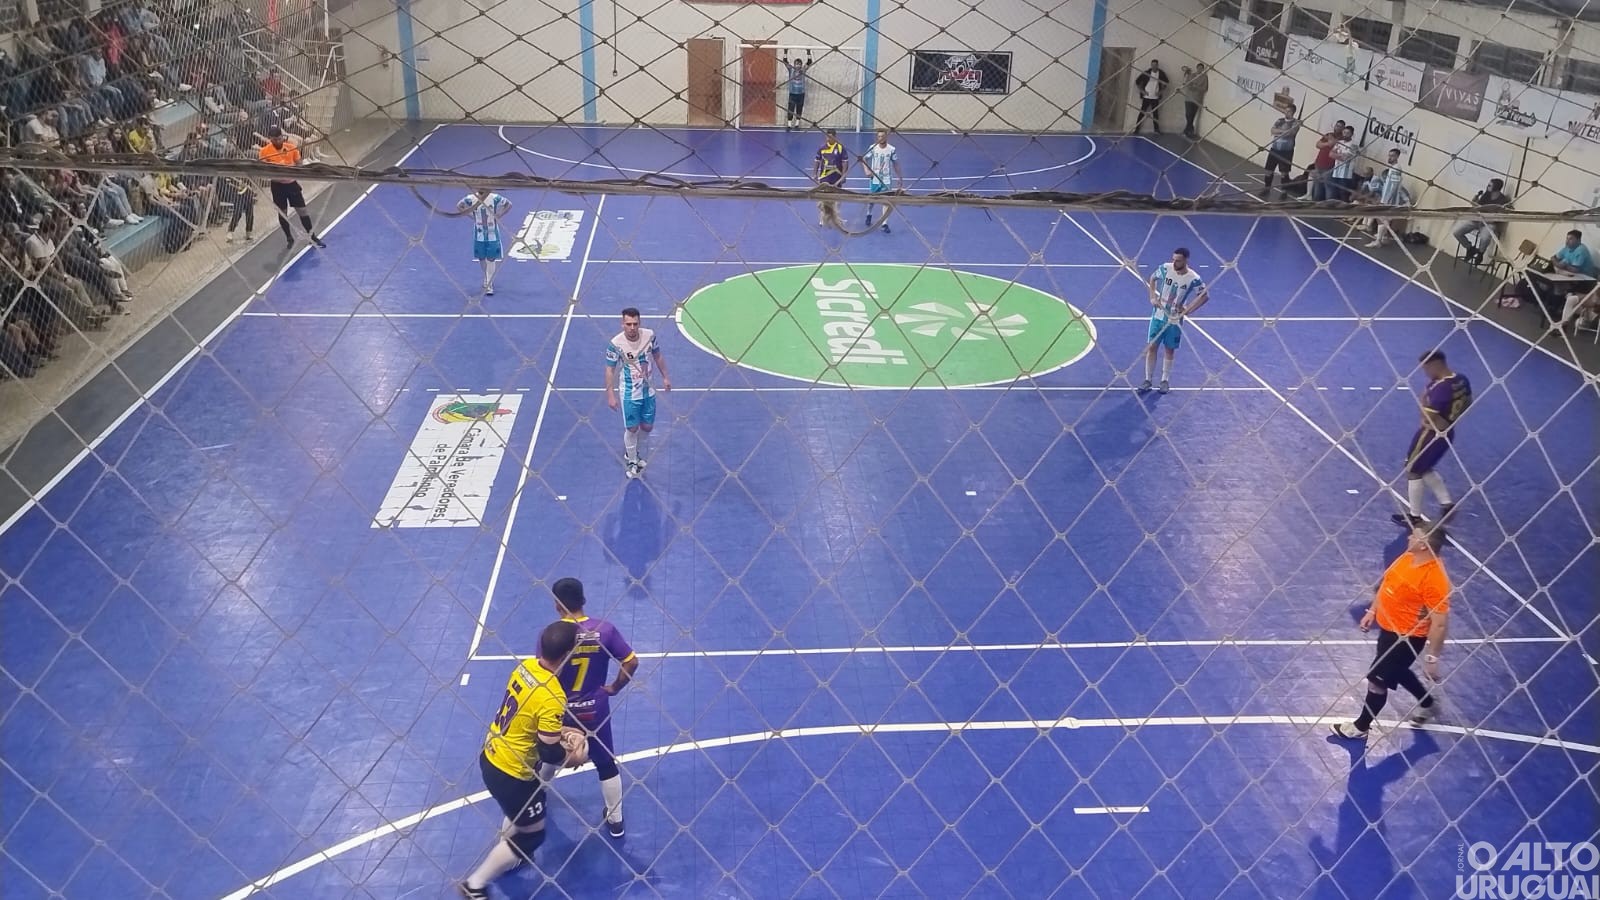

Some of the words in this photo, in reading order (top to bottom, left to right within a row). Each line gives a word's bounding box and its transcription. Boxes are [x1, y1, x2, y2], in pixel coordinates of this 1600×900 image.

[1386, 78, 1417, 94] ALMEIDA
[811, 277, 908, 364] Sicredi
[435, 443, 450, 453] de
[454, 457, 470, 467] de
[433, 469, 467, 518] Vereadores
[570, 657, 590, 692] 7
[527, 801, 543, 818] 13
